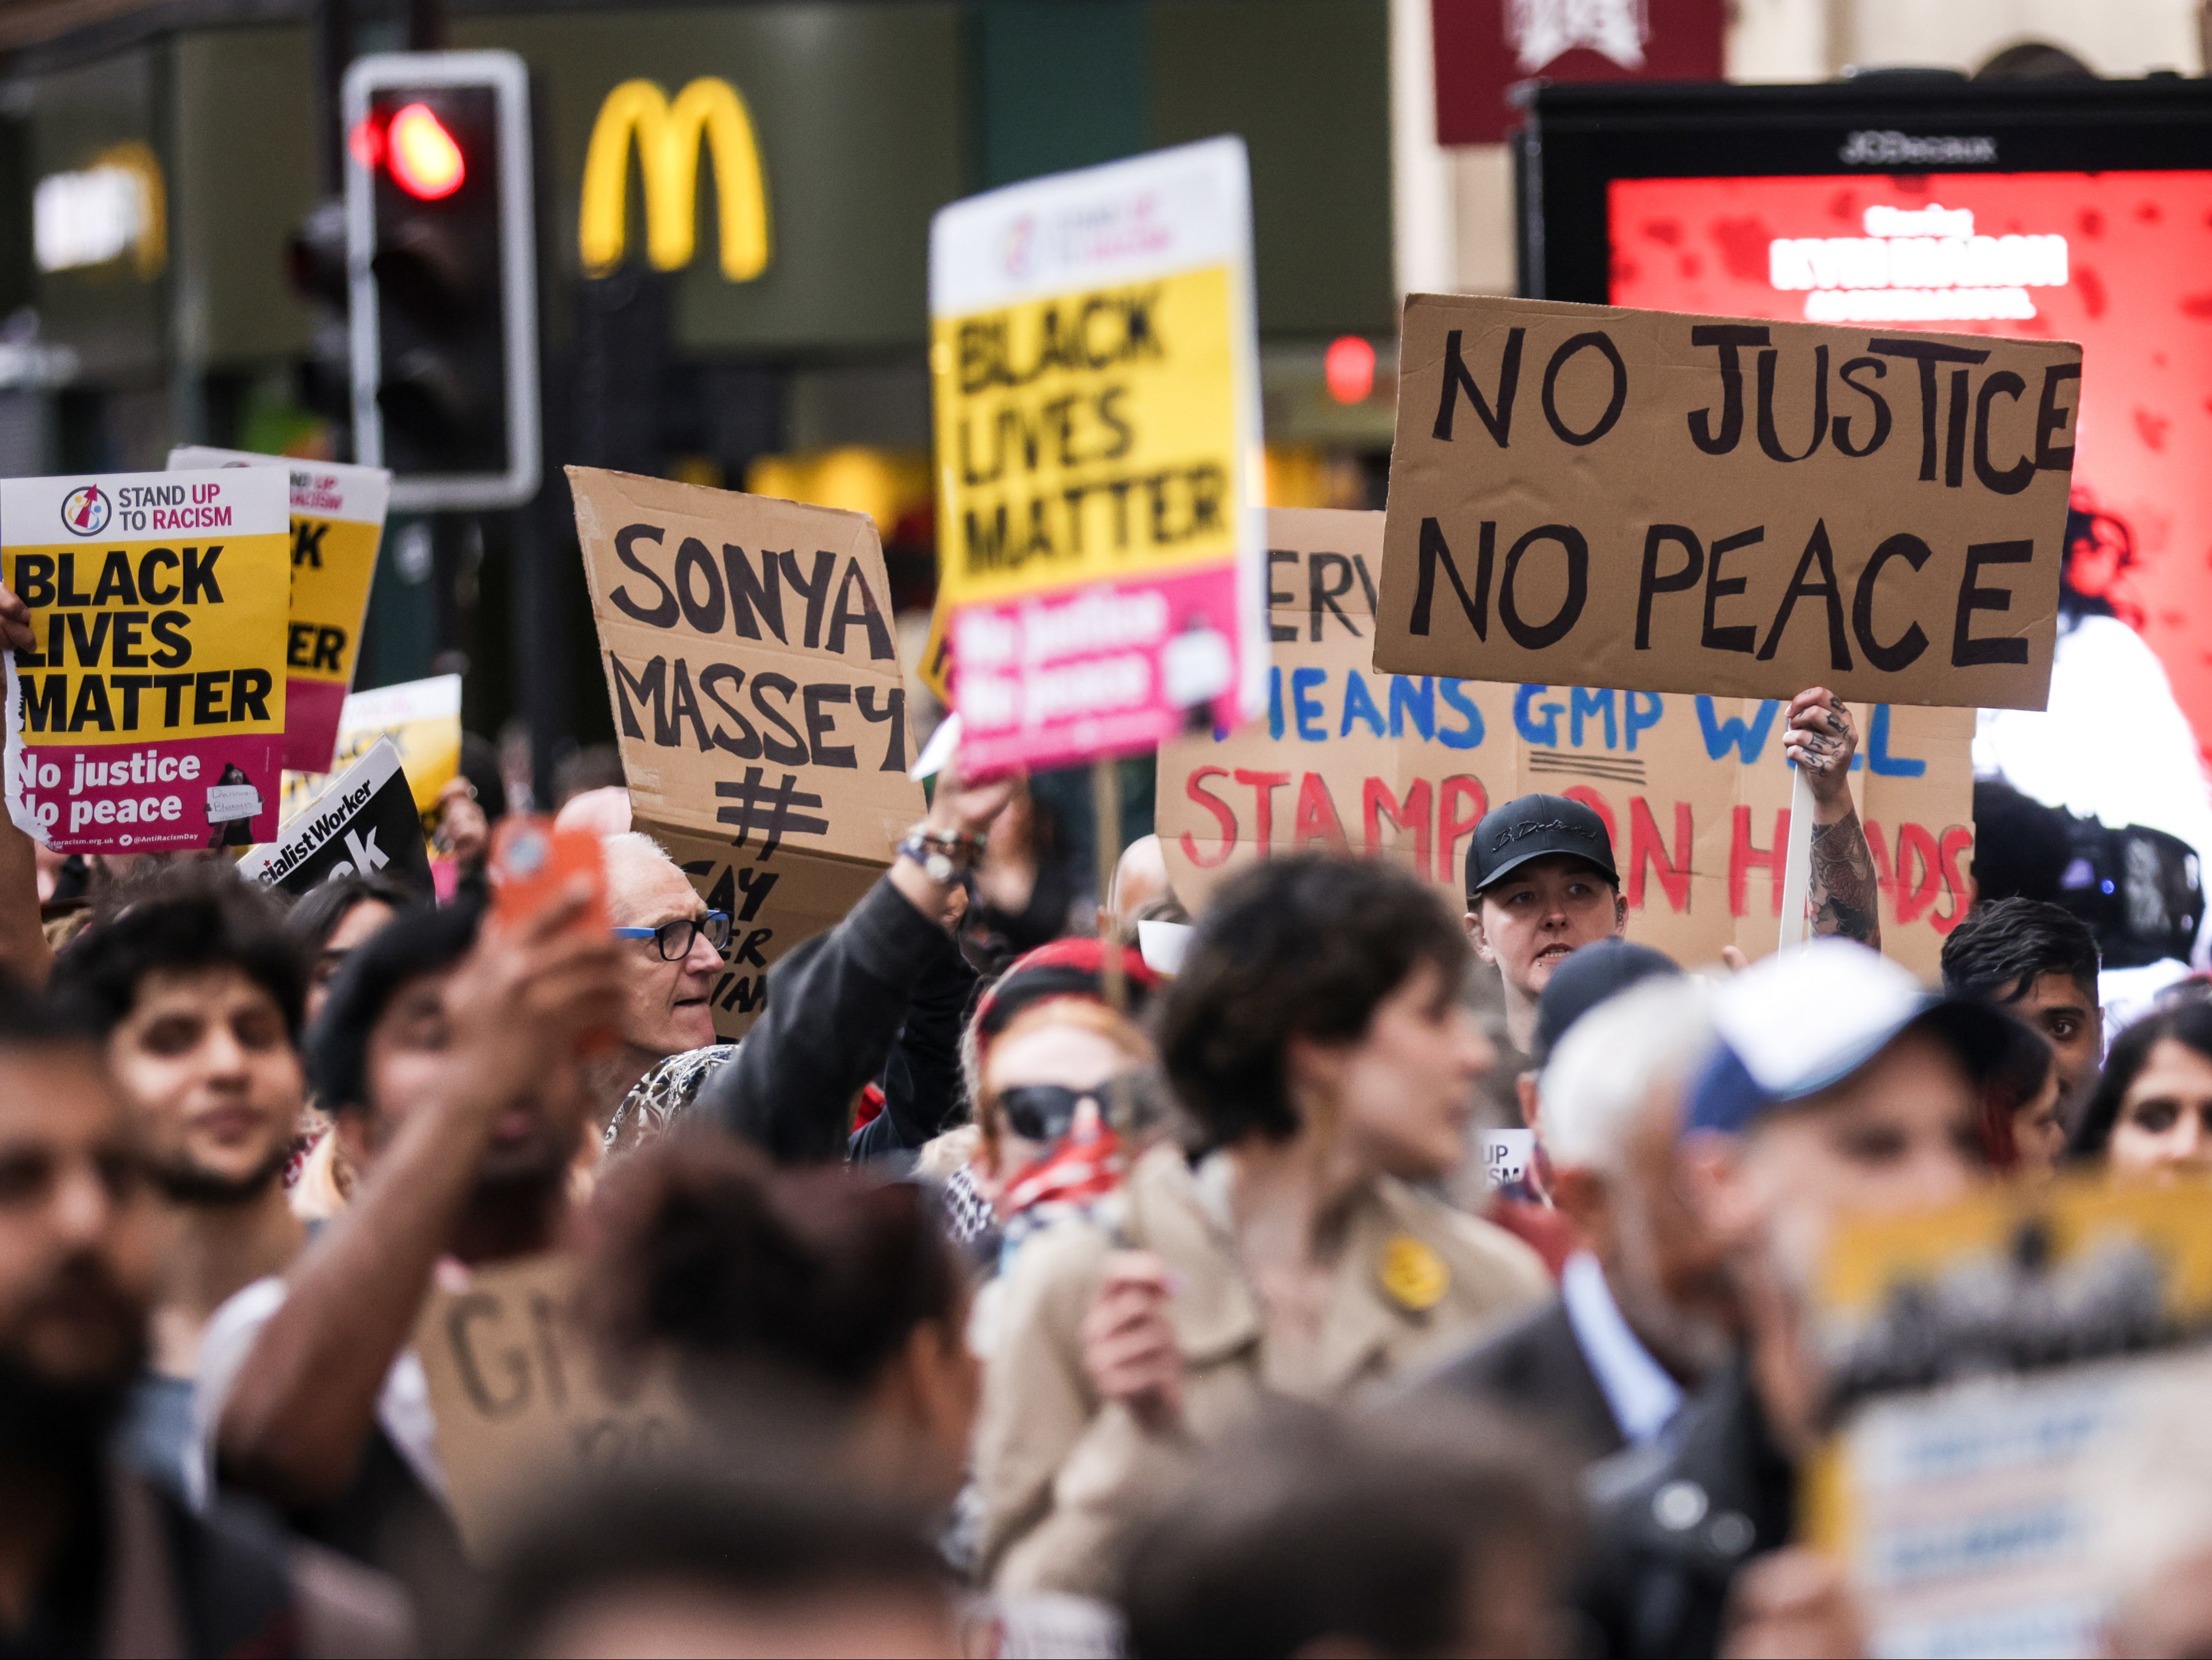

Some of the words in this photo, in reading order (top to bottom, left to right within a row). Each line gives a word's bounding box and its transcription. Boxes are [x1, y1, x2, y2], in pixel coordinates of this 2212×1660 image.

[1432, 327, 1628, 448] NO
[1688, 325, 2082, 495] JUSTICE
[119, 485, 186, 508] STAND
[192, 484, 221, 504] UP
[119, 510, 147, 531] TO
[153, 506, 232, 530] RACISM
[15, 545, 224, 608] BLACK
[609, 524, 895, 660] SONYA
[1409, 517, 1589, 650] NO
[1635, 517, 2034, 672] PEACE
[18, 668, 273, 732] MATTER
[609, 650, 907, 772] MASSEY
[1514, 683, 1664, 752] GMP
[70, 749, 201, 795] justice
[70, 795, 182, 833] peace
[134, 833, 199, 844] @AntiRacismDay
[1181, 766, 1489, 884] STAMP
[1729, 805, 1973, 934] HADS
